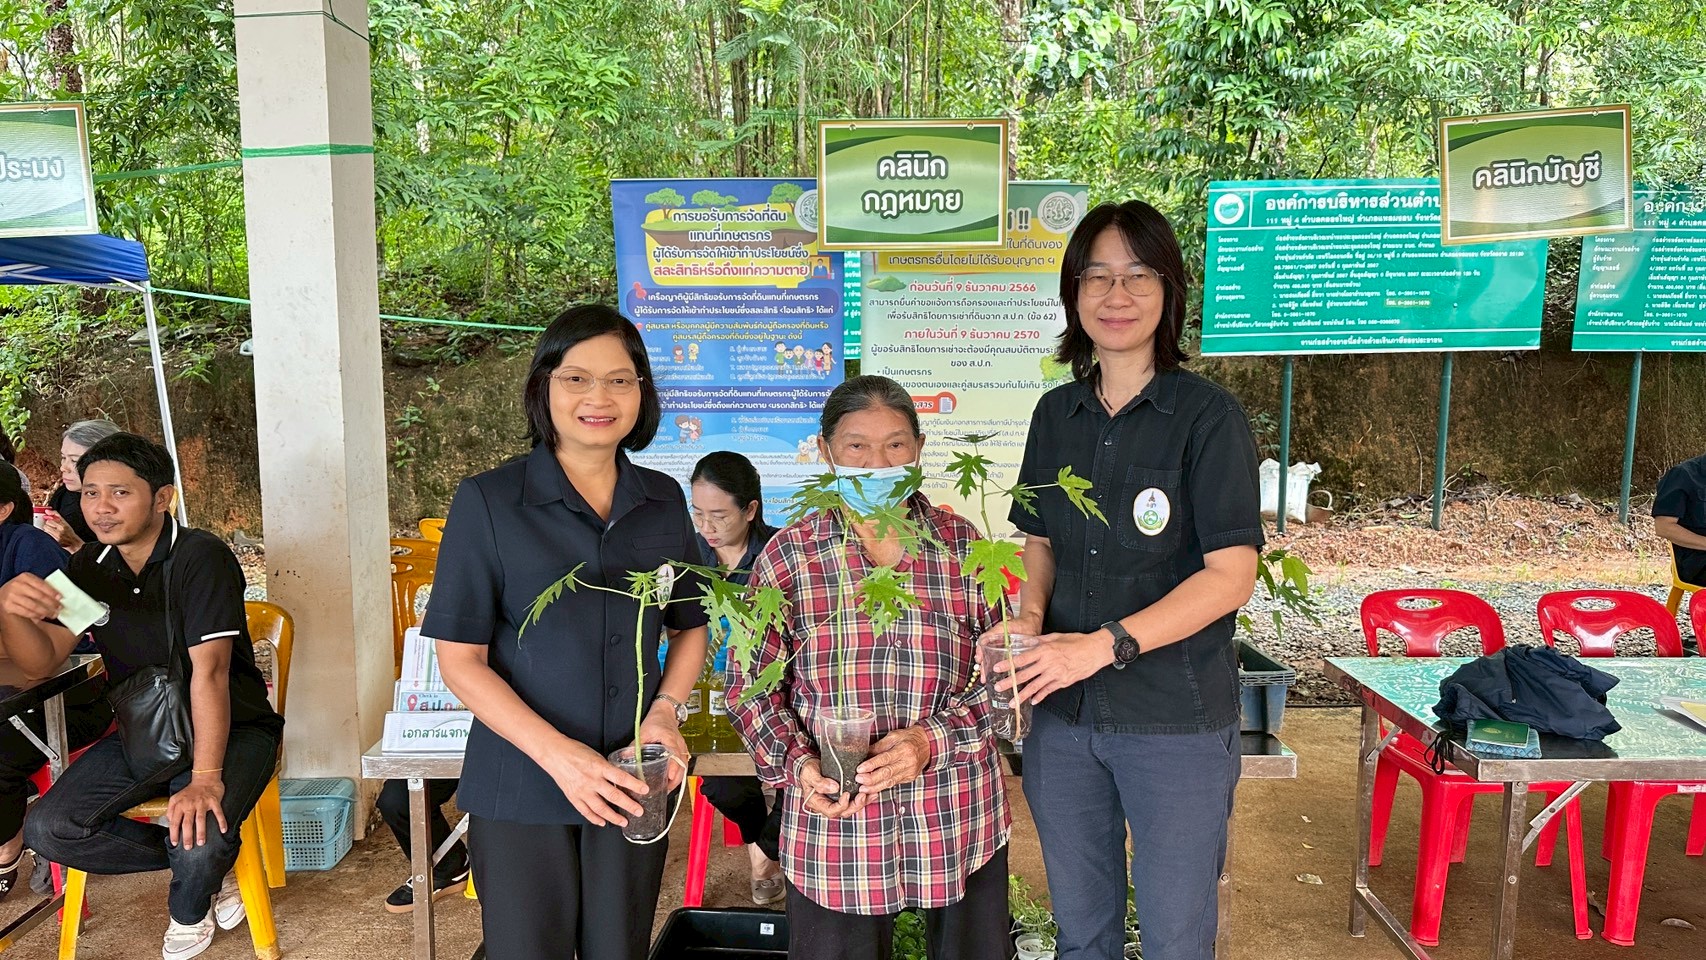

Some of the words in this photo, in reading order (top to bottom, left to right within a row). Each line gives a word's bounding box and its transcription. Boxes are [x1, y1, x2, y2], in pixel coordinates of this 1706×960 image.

[878, 152, 947, 179] คลินิก
[1474, 153, 1601, 189] คลินิกบัญชี
[862, 190, 962, 218] กฎหมาย
[672, 204, 787, 222] การขอรับการจัดที่ดิน
[689, 224, 772, 242] แทนที่เกษตรกร
[1007, 235, 1063, 249] ในที่ดินของ
[652, 242, 809, 262] ผู้ได้รับการจัดให้เข้าทำประโยชน์ซึ่ง
[889, 251, 1045, 268] เกษตรกรอื่นโดยไม่ได้รับอนุญาต
[653, 261, 809, 277] สละสิทธิหรือถึงแก่ความตาย
[909, 276, 954, 292] ก่อนวันที่
[956, 283, 962, 292] 9
[965, 282, 1007, 292] ธันวาคม
[1009, 283, 1037, 292] 2566
[886, 309, 1001, 321] เพื่อรับสิทธิโดยการเช่าที่ดินจาก
[1002, 312, 1026, 320] ส.ป.ก.
[1027, 311, 1042, 321] (ข้อ
[1042, 312, 1057, 321] 62)
[904, 324, 959, 340] ภายในวันที่
[960, 330, 968, 339] 9
[970, 328, 1010, 340] ธันวาคม
[1013, 330, 1040, 340] 2570
[870, 344, 1059, 359] ผู้ขอรับสิทธิโดยการเช่าจะต้องมีคุณสมบัติตามระ
[882, 366, 933, 376] เป็นเกษตรกร
[969, 358, 993, 368] ส.ป.ก.
